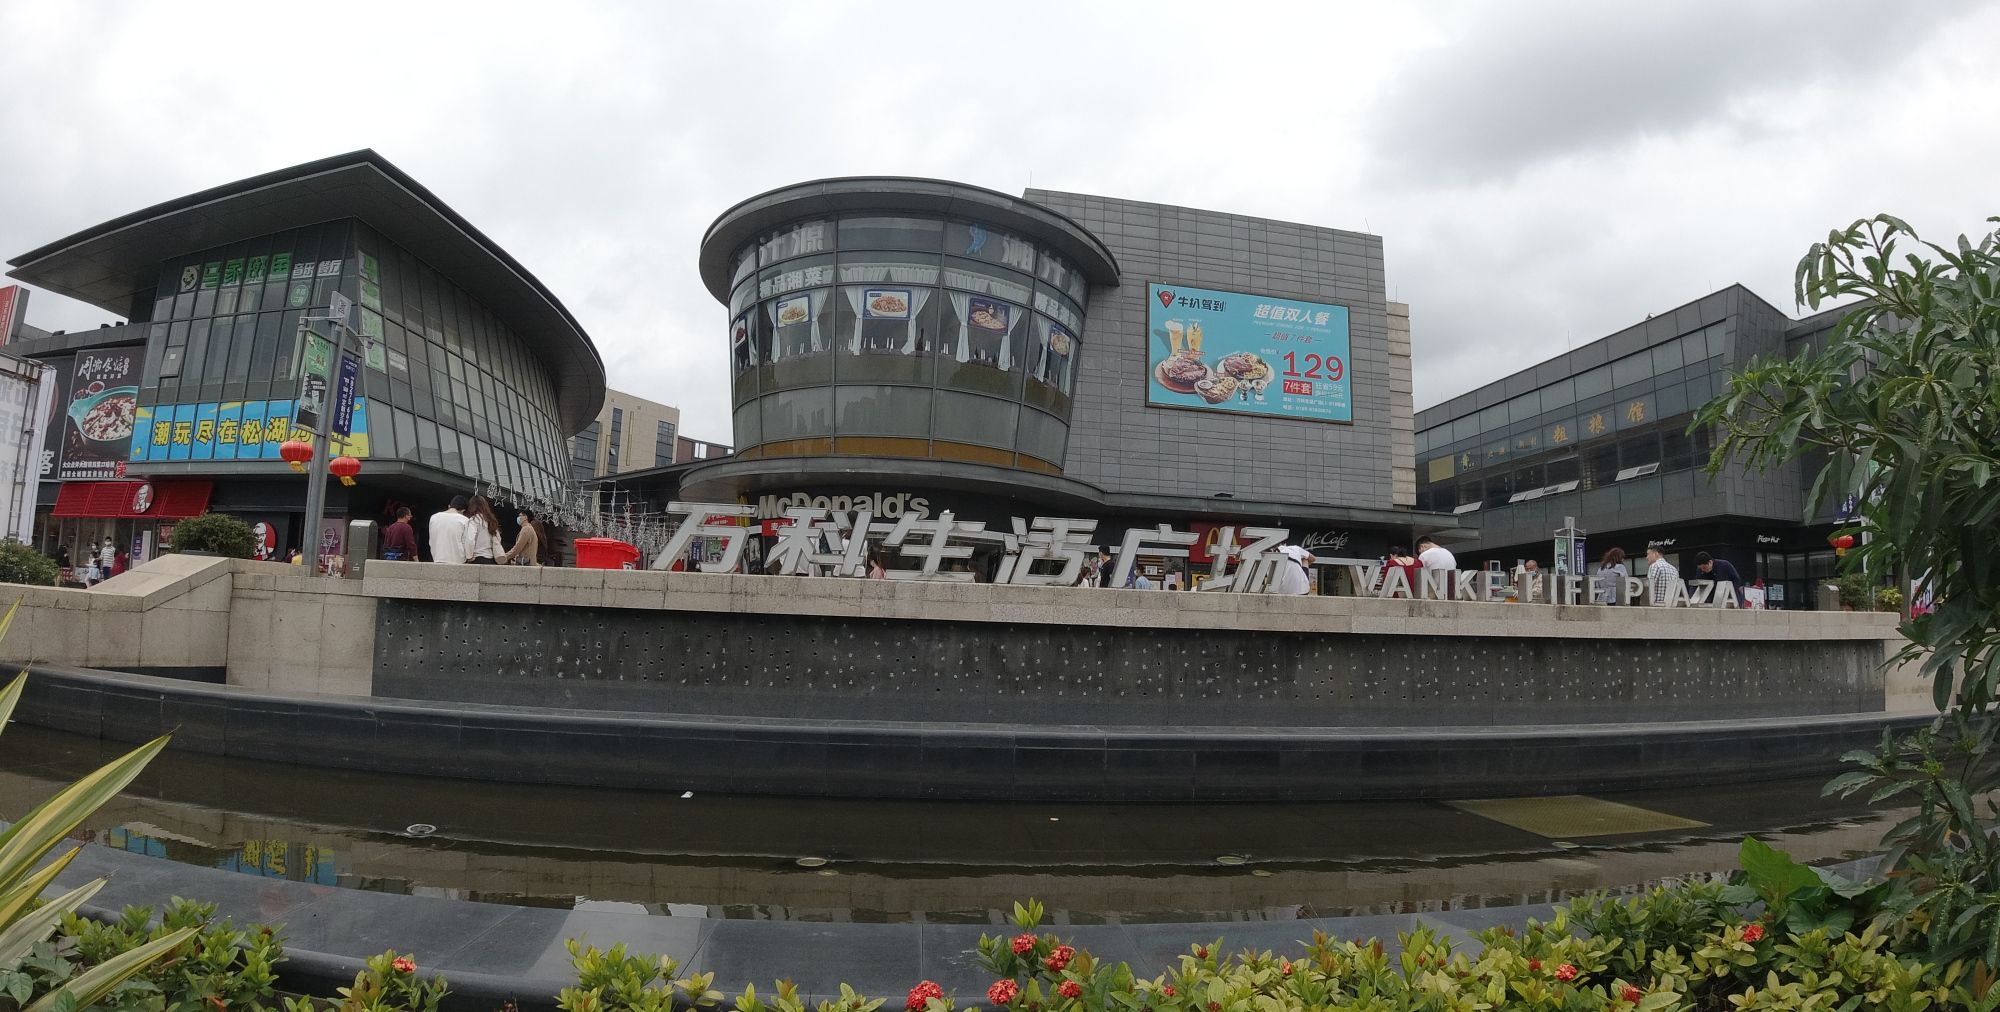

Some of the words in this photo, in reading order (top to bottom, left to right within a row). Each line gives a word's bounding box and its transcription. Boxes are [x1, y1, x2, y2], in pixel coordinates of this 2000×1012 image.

[1178, 296, 1225, 312] 牛扒驾到
[1253, 303, 1330, 326] 超值双人餐
[1283, 351, 1344, 382] 129
[1284, 381, 1312, 394] 7件套
[1552, 400, 1644, 443] 粗粮馆
[758, 491, 930, 519] McDonald's
[649, 501, 1289, 594] 万科生活广场
[1664, 538, 1676, 546] Hut
[1350, 565, 1505, 602] VANKE
[1619, 576, 1739, 609] PLAZA
